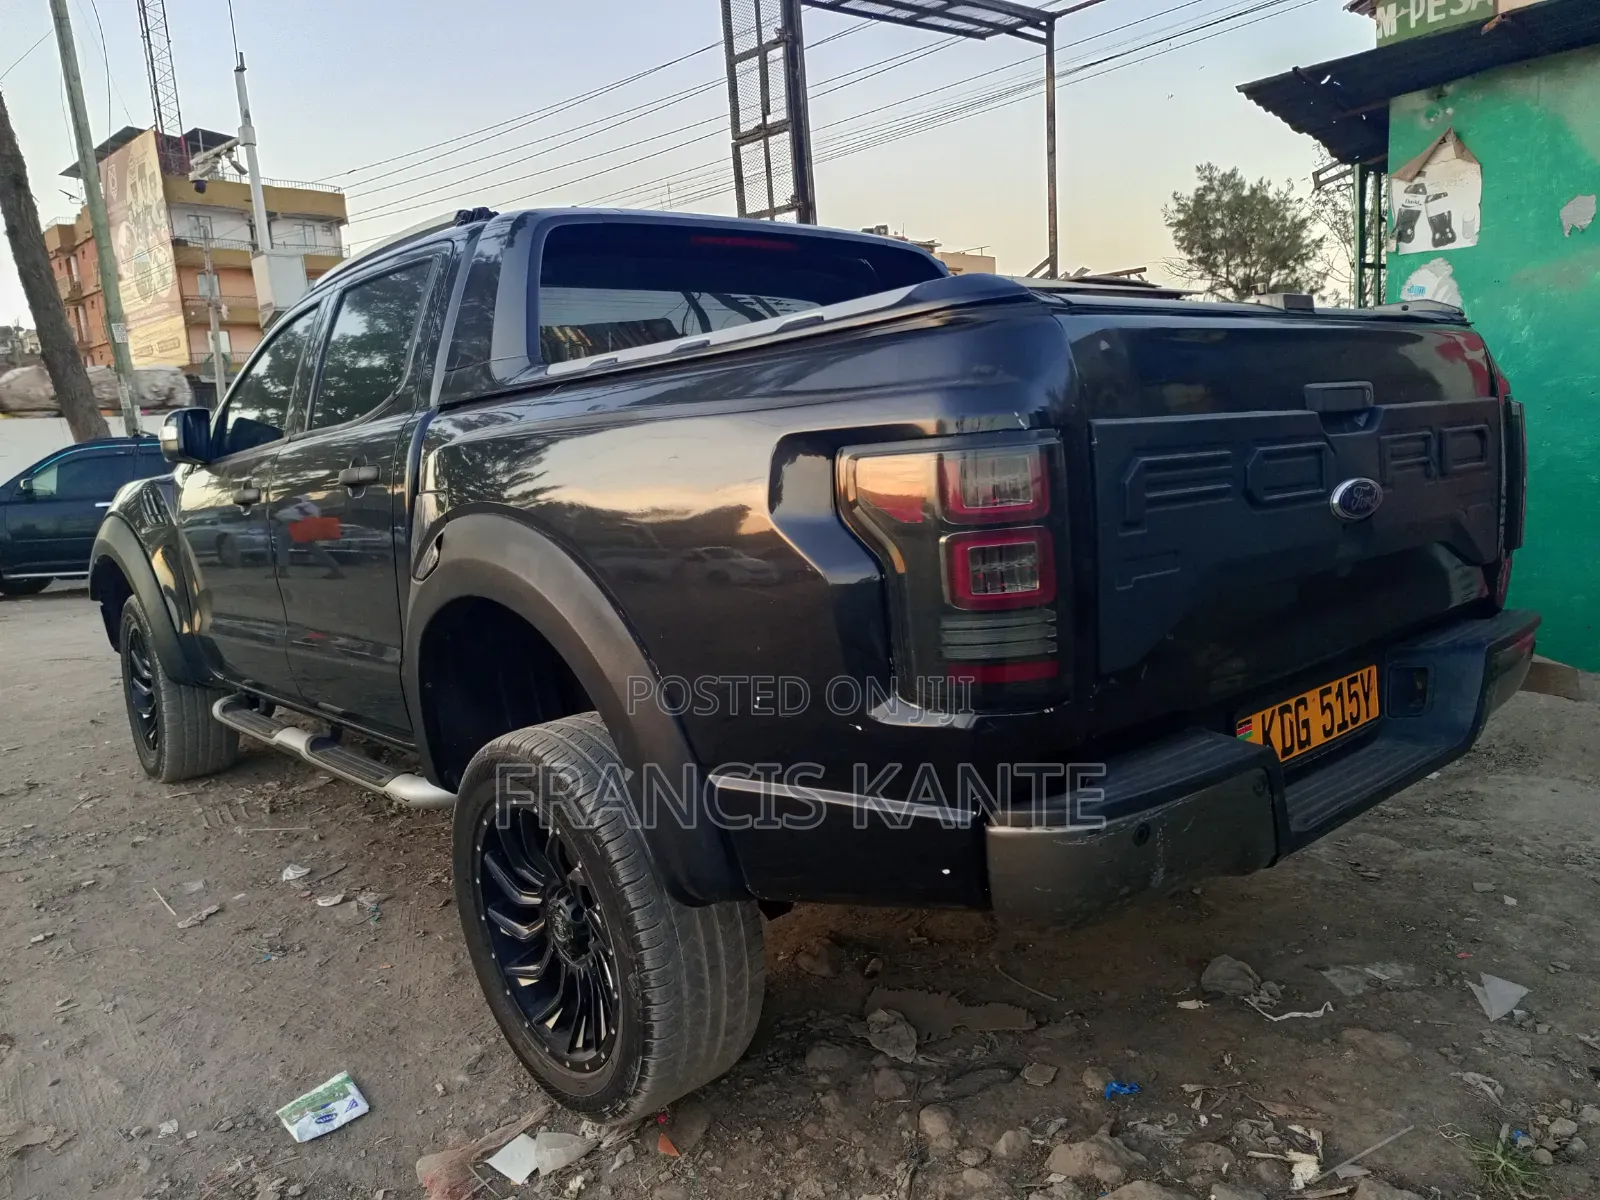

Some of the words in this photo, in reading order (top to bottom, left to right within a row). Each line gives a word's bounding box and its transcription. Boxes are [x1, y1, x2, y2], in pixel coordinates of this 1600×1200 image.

[1115, 422, 1494, 537] FORD
[1351, 484, 1378, 510] Ford
[1261, 696, 1312, 759] KDG
[1319, 669, 1372, 738] 515Y
